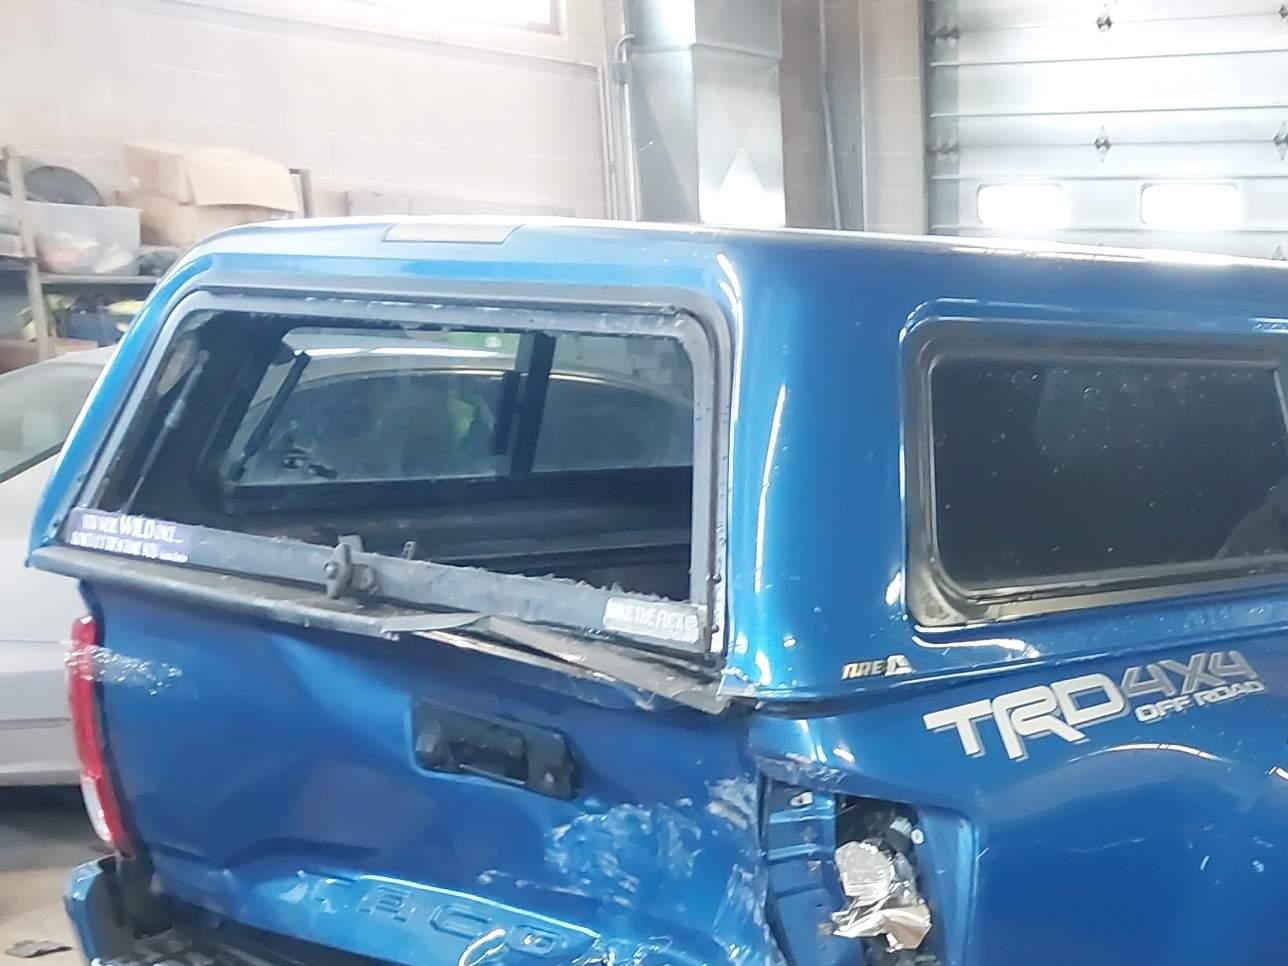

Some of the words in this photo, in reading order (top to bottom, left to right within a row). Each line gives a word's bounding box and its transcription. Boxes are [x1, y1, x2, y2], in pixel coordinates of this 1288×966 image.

[923, 673, 1130, 761] TRD
[1121, 650, 1260, 698] 4X4
[1135, 695, 1192, 722] OFF
[1193, 681, 1266, 707] ROAD
